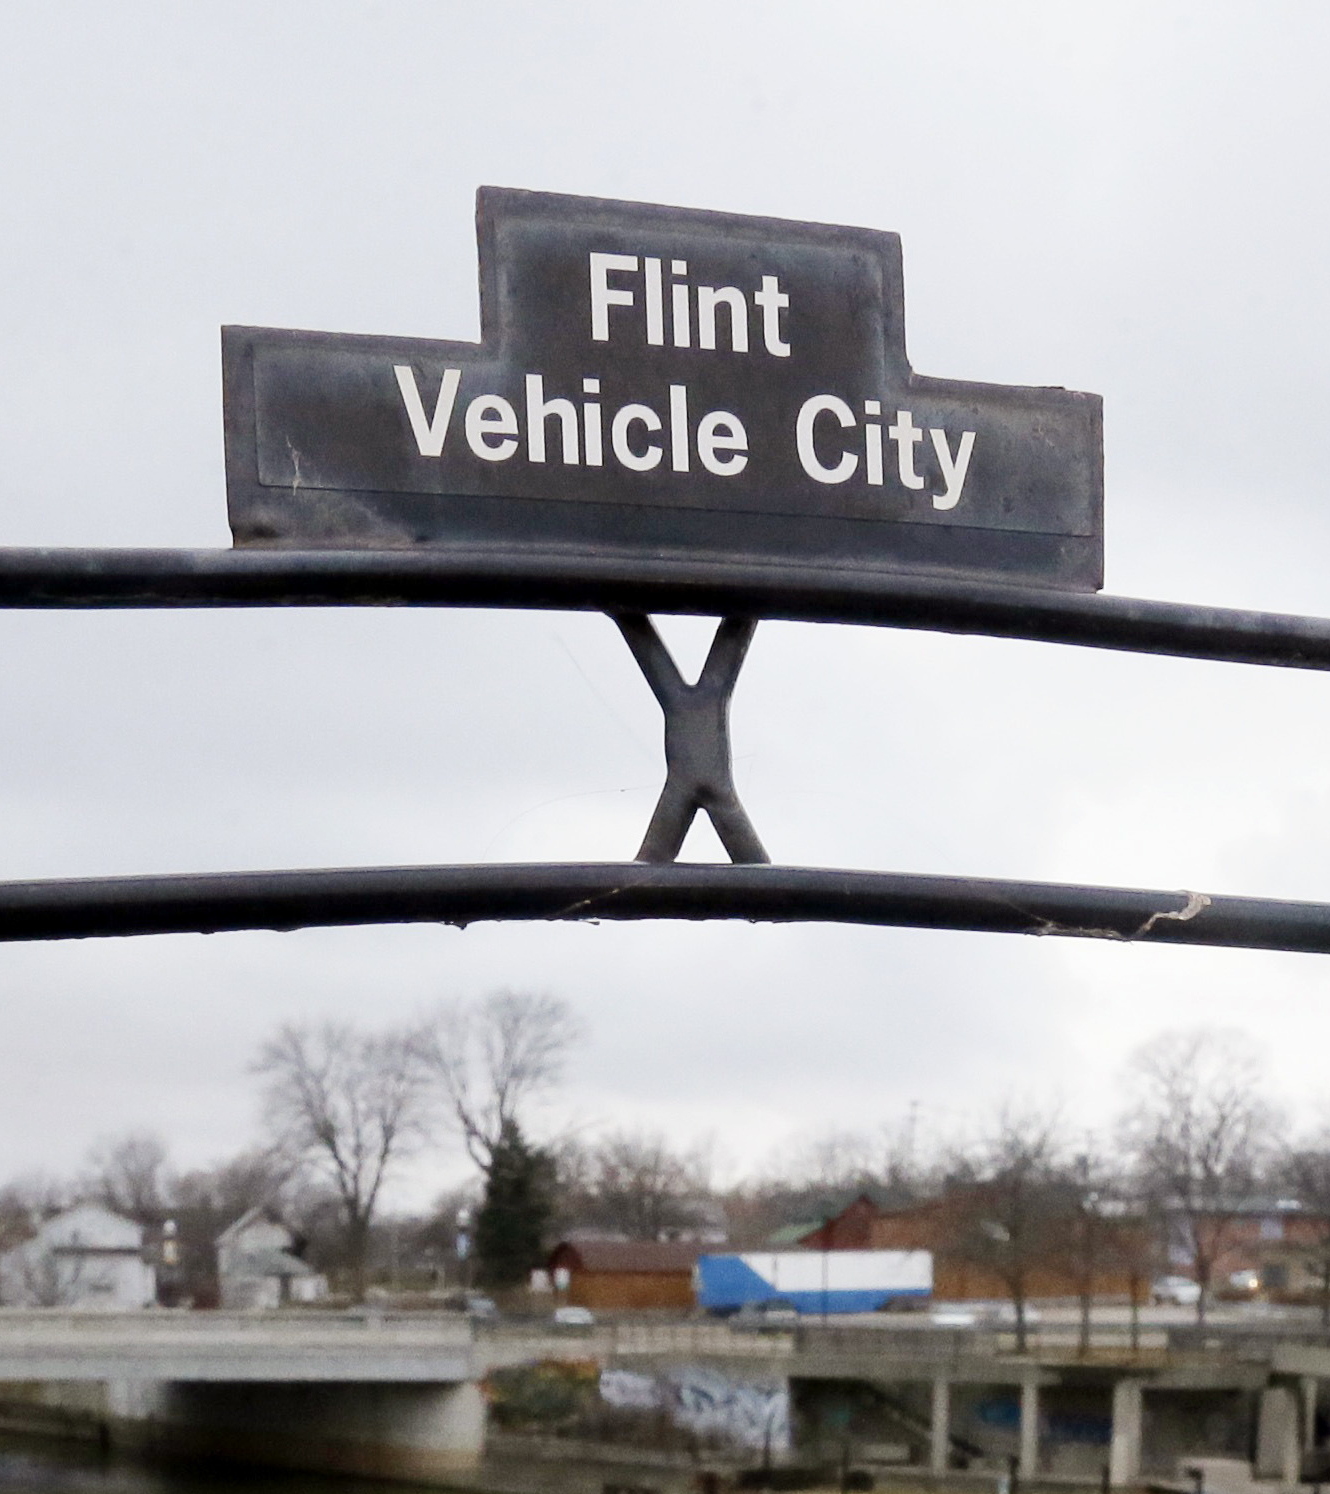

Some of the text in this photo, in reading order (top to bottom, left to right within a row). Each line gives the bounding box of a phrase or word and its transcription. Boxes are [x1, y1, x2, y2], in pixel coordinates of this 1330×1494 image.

[589, 251, 791, 358] Flint
[393, 364, 977, 511] Vehicle City
